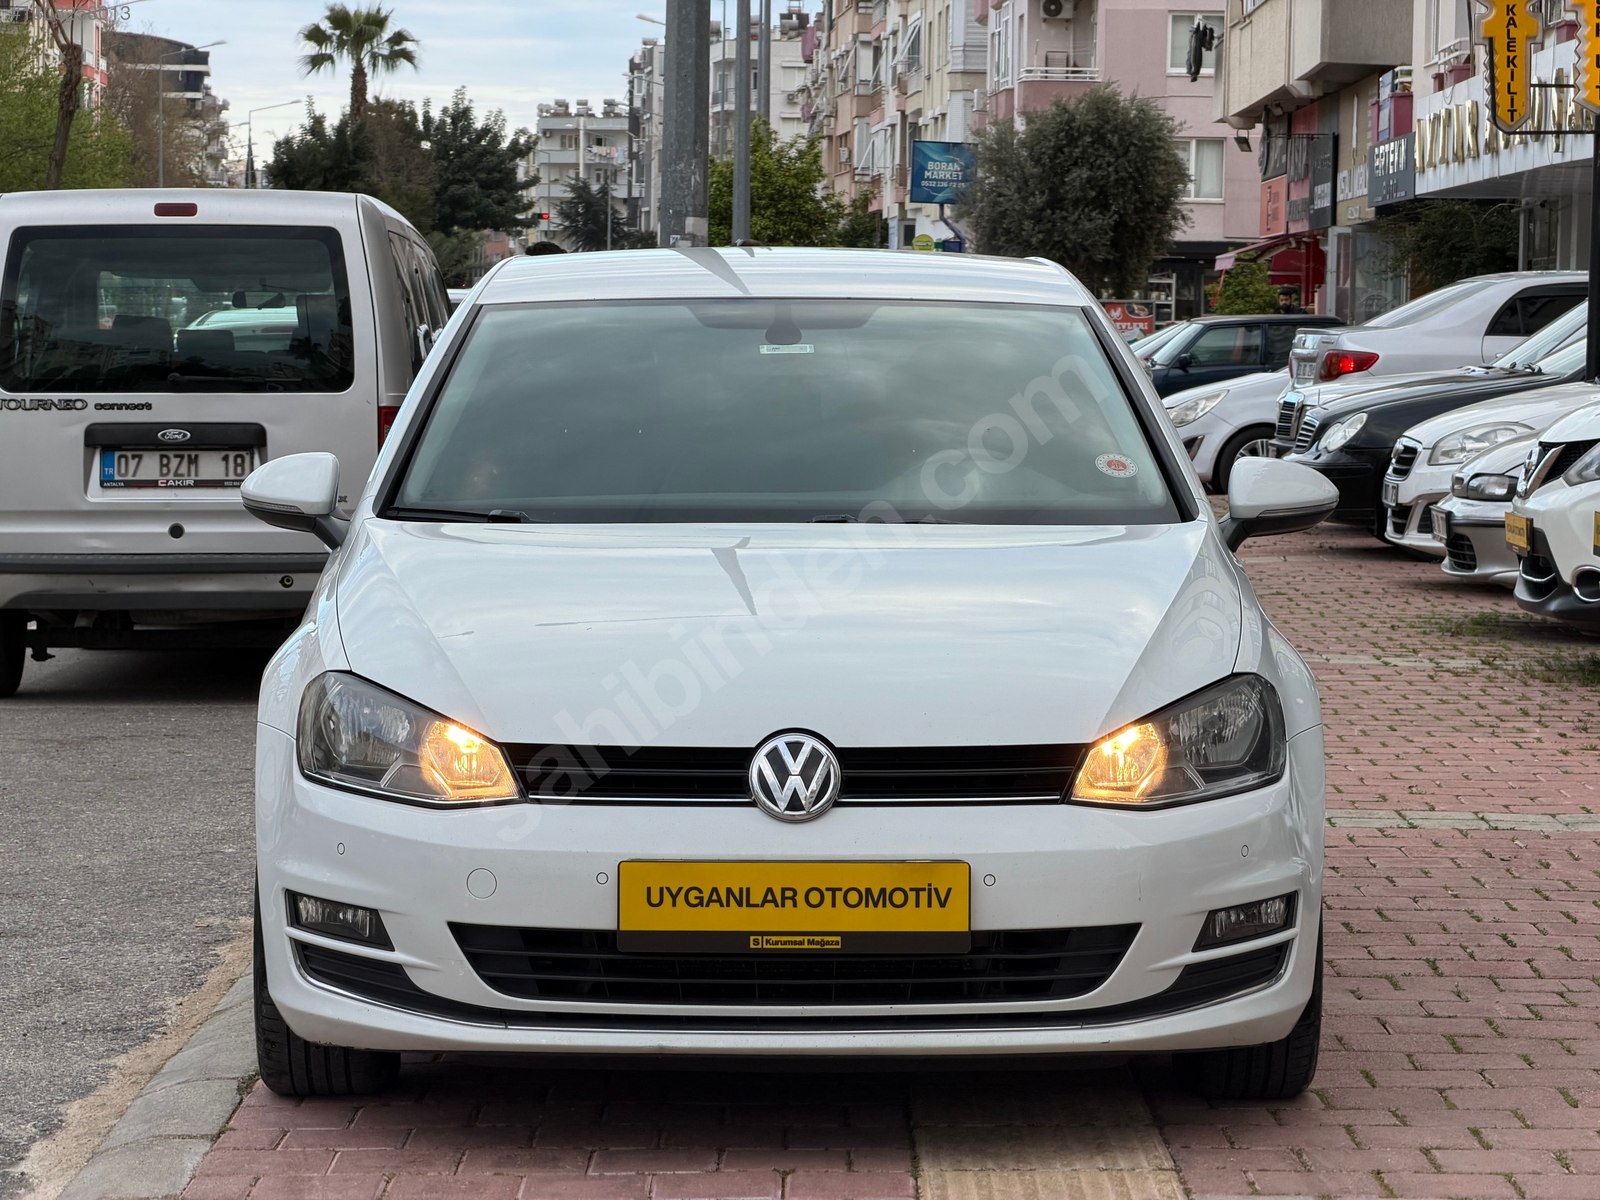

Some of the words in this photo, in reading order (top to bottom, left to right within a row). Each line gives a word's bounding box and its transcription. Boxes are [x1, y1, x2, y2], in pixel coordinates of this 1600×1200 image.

[924, 170, 962, 180] MARKET
[0, 398, 88, 411] TOURNEO
[94, 401, 153, 411] connect
[104, 467, 114, 475] TR
[116, 453, 143, 478] 07
[159, 453, 199, 478] BZM
[646, 886, 798, 909] UYGANLAR
[804, 882, 953, 909] OTOMOTİV
[752, 937, 760, 946] S
[765, 938, 805, 946] Kurumsal
[807, 938, 840, 948] Mağaza
